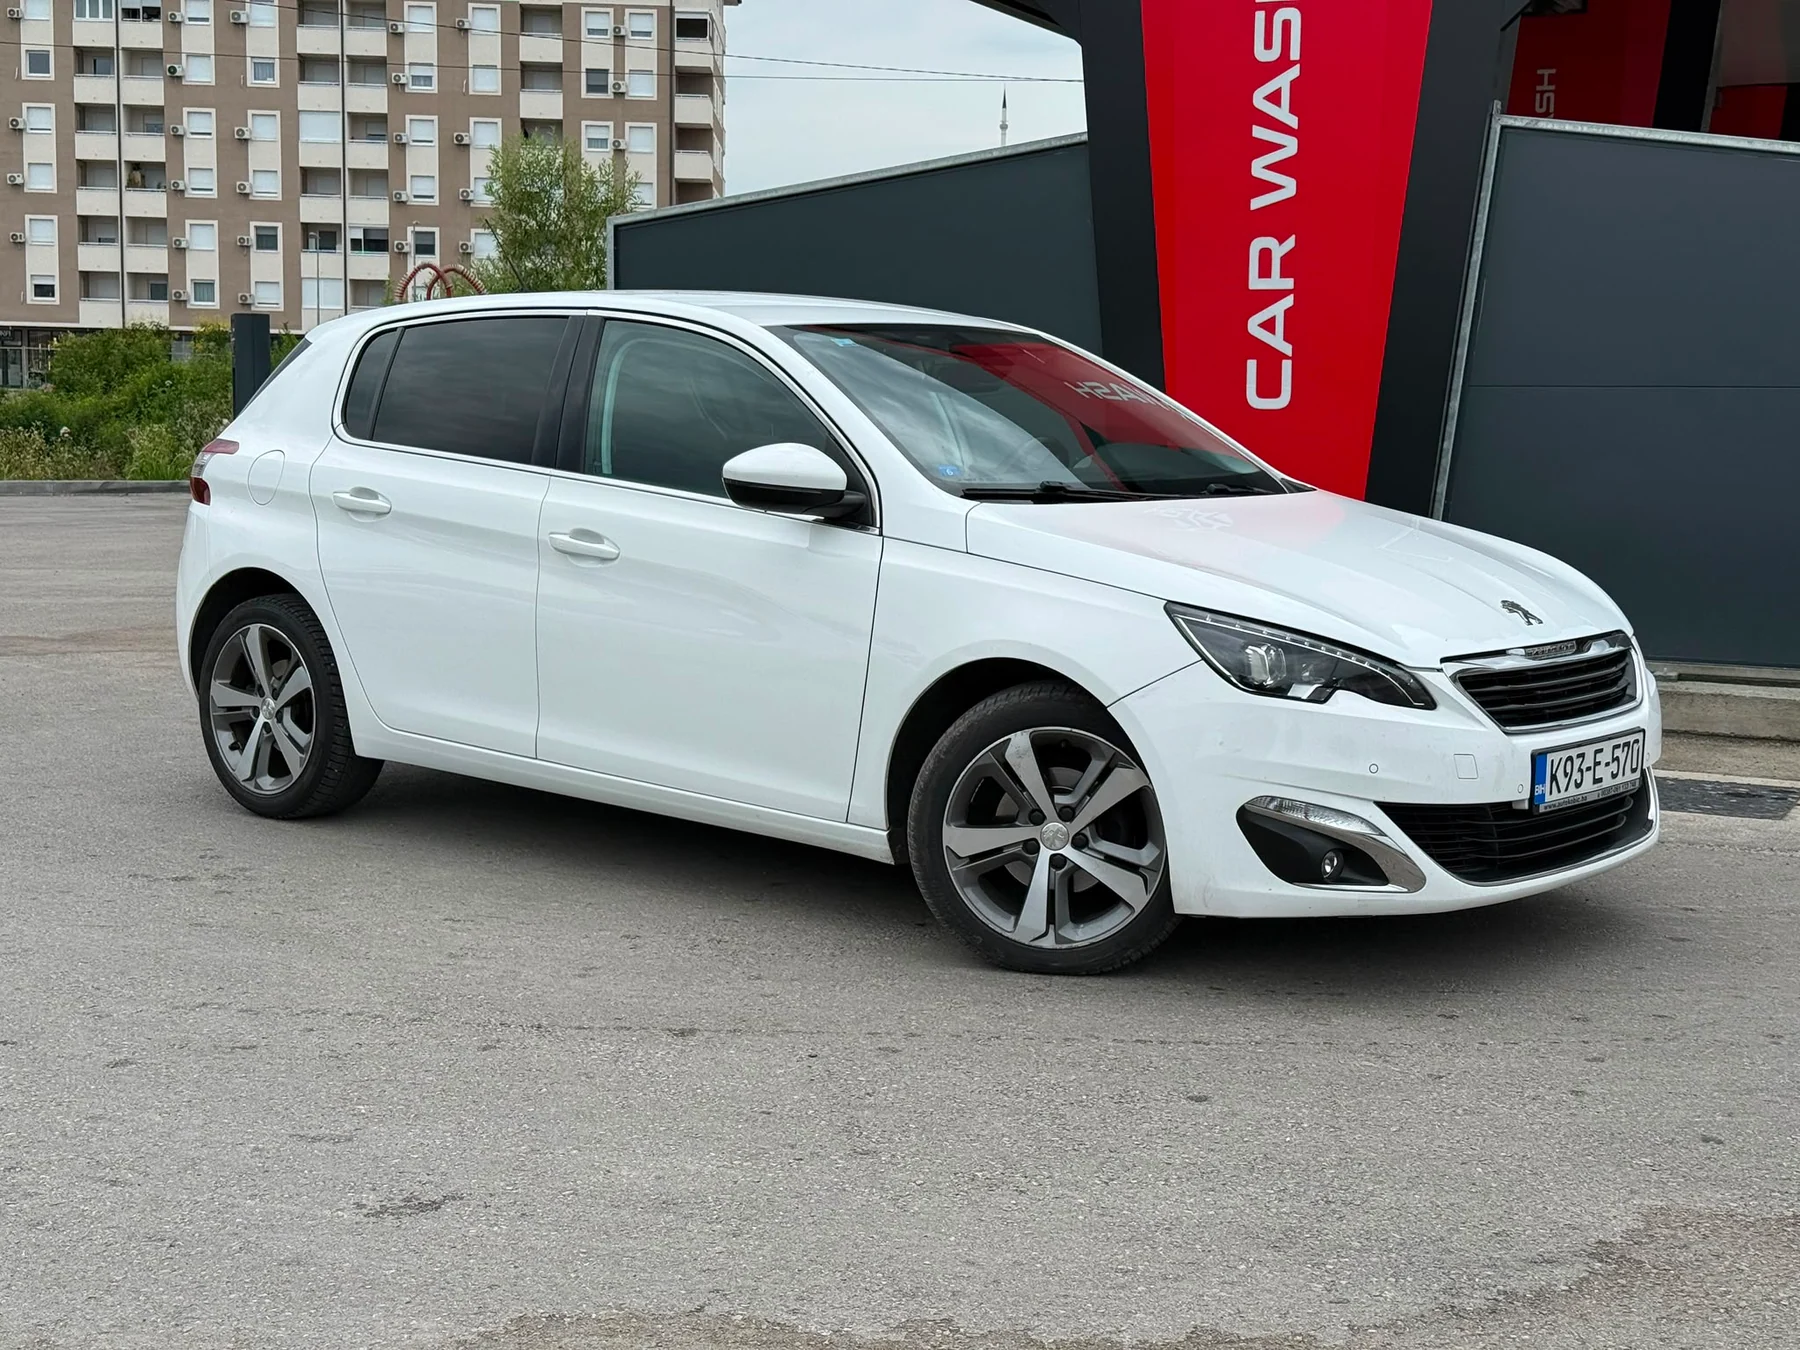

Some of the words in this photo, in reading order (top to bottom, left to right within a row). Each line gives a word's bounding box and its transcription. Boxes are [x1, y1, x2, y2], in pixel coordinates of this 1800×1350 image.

[1250, 0, 1301, 210] WAS
[1535, 68, 1556, 118] SH
[1246, 235, 1295, 409] CAR
[1549, 738, 1640, 796] K93-E-570
